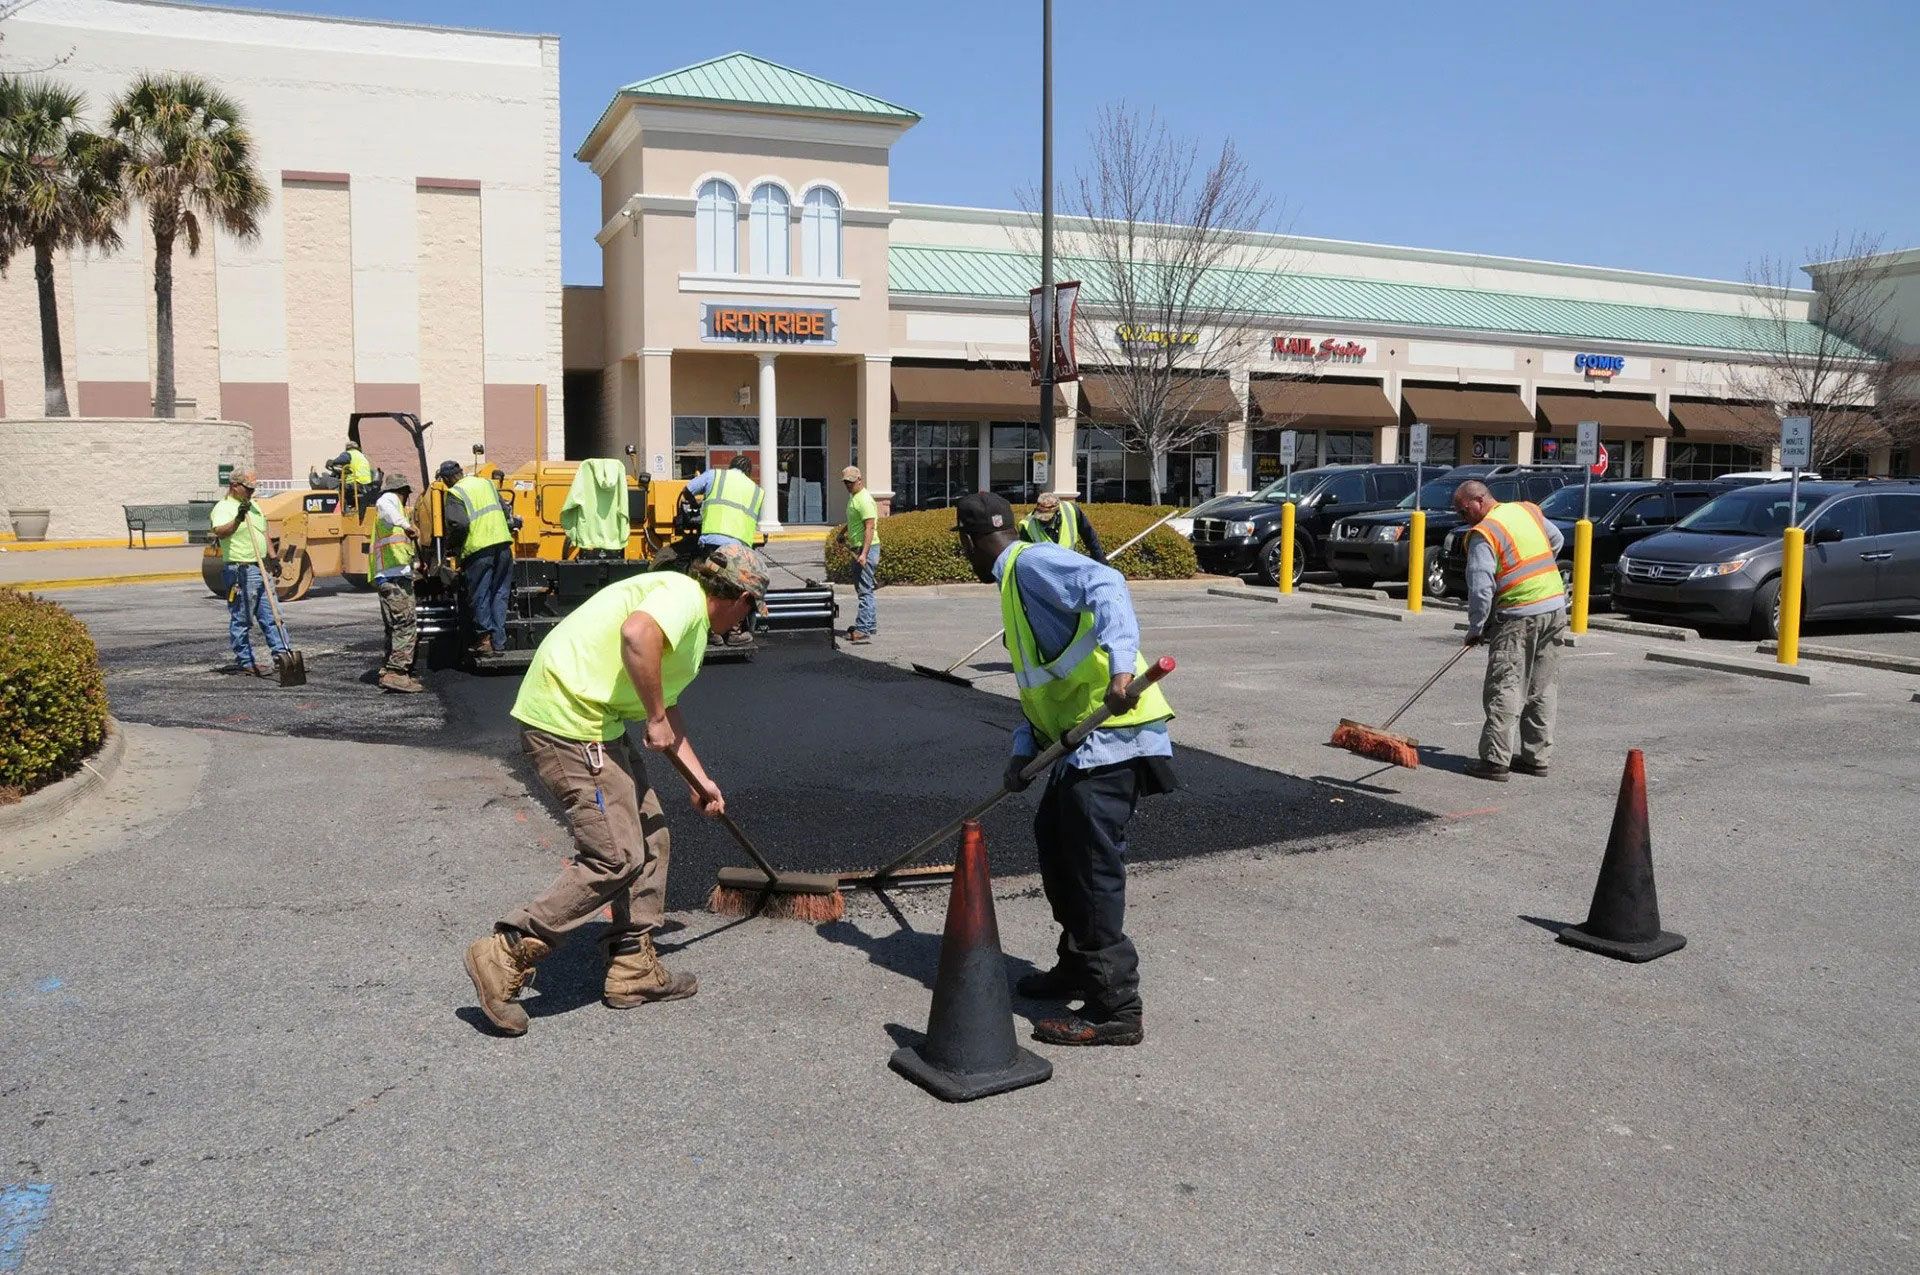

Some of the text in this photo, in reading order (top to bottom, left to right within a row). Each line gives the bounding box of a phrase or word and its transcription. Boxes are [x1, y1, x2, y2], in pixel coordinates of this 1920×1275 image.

[1272, 336, 1315, 356] NAIL
[1575, 353, 1625, 370] COMIC
[1587, 368, 1613, 377] SHOP
[306, 498, 323, 512] CAT
